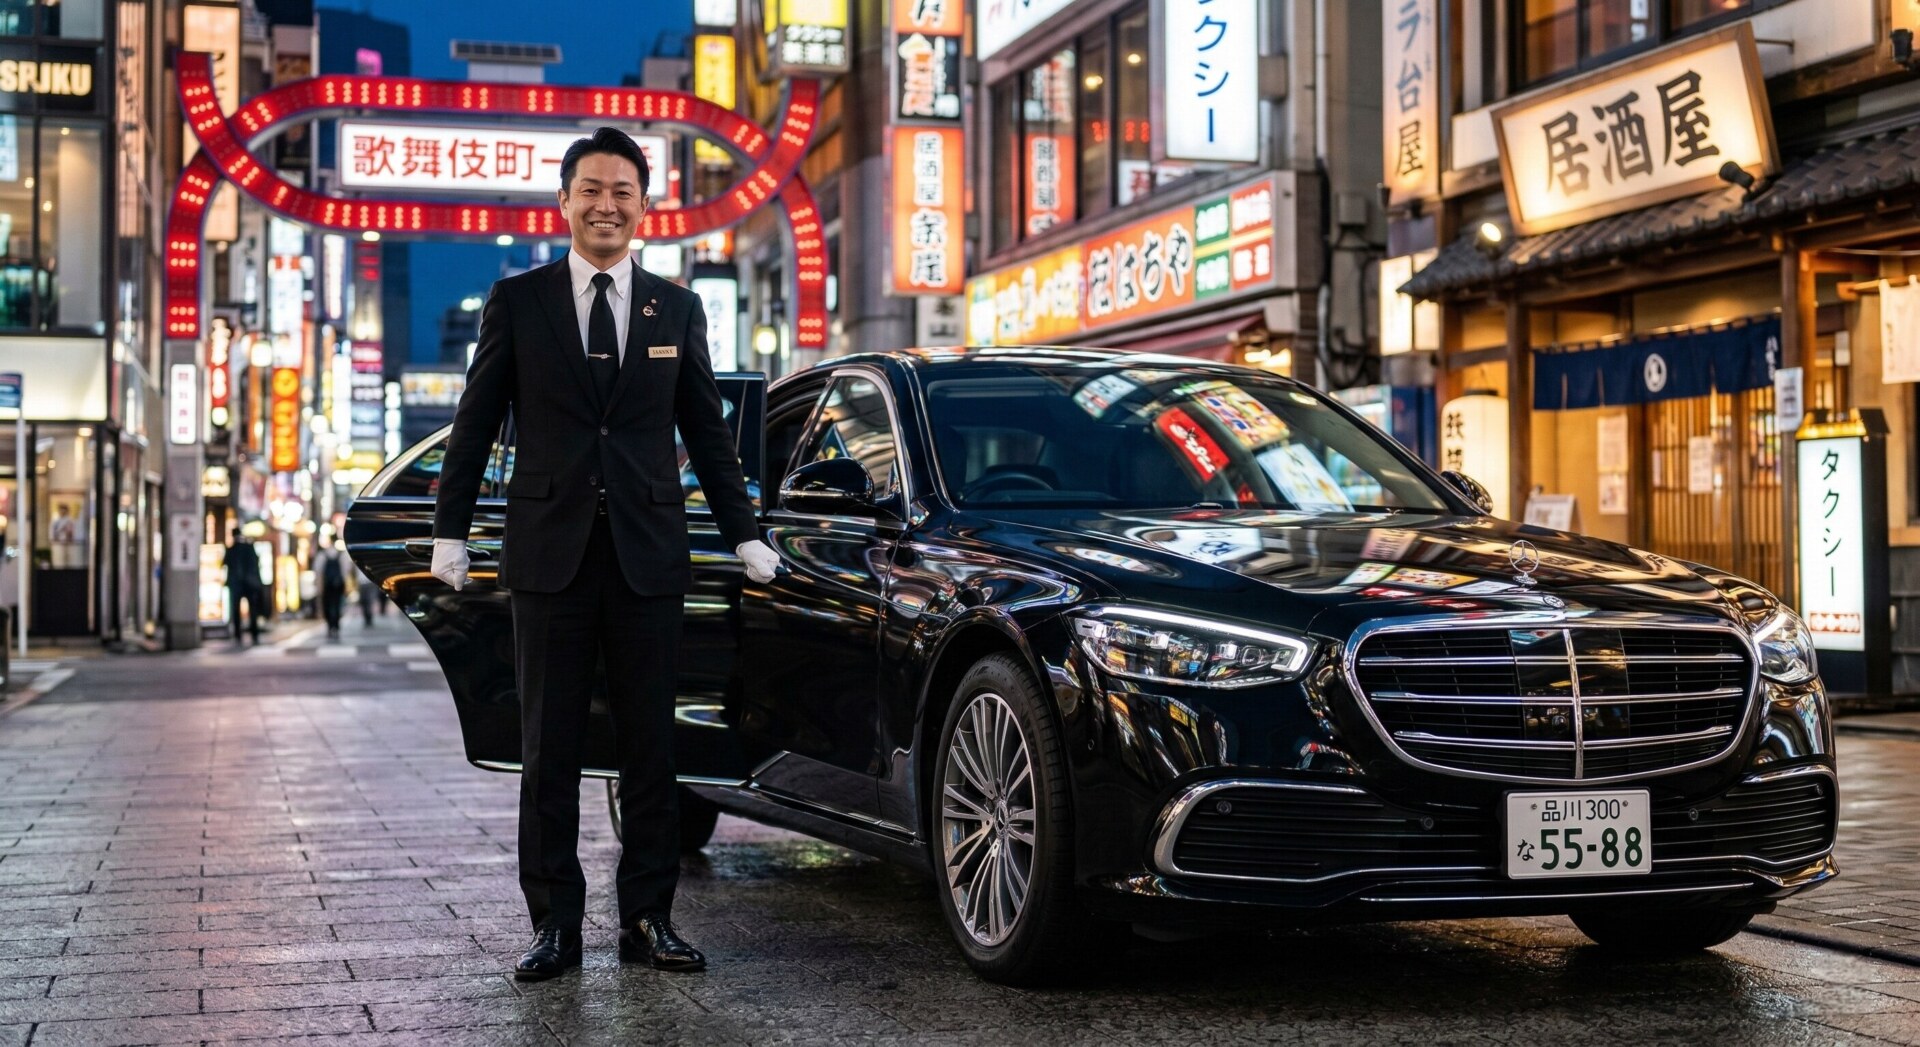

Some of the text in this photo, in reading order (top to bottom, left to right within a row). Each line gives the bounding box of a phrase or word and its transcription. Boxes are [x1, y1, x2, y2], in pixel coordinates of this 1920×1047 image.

[1194, 0, 1229, 143] クシー
[1541, 70, 1720, 198] 居酒屋
[1821, 447, 1842, 597] タクシー
[1540, 826, 1644, 871] 55-88
